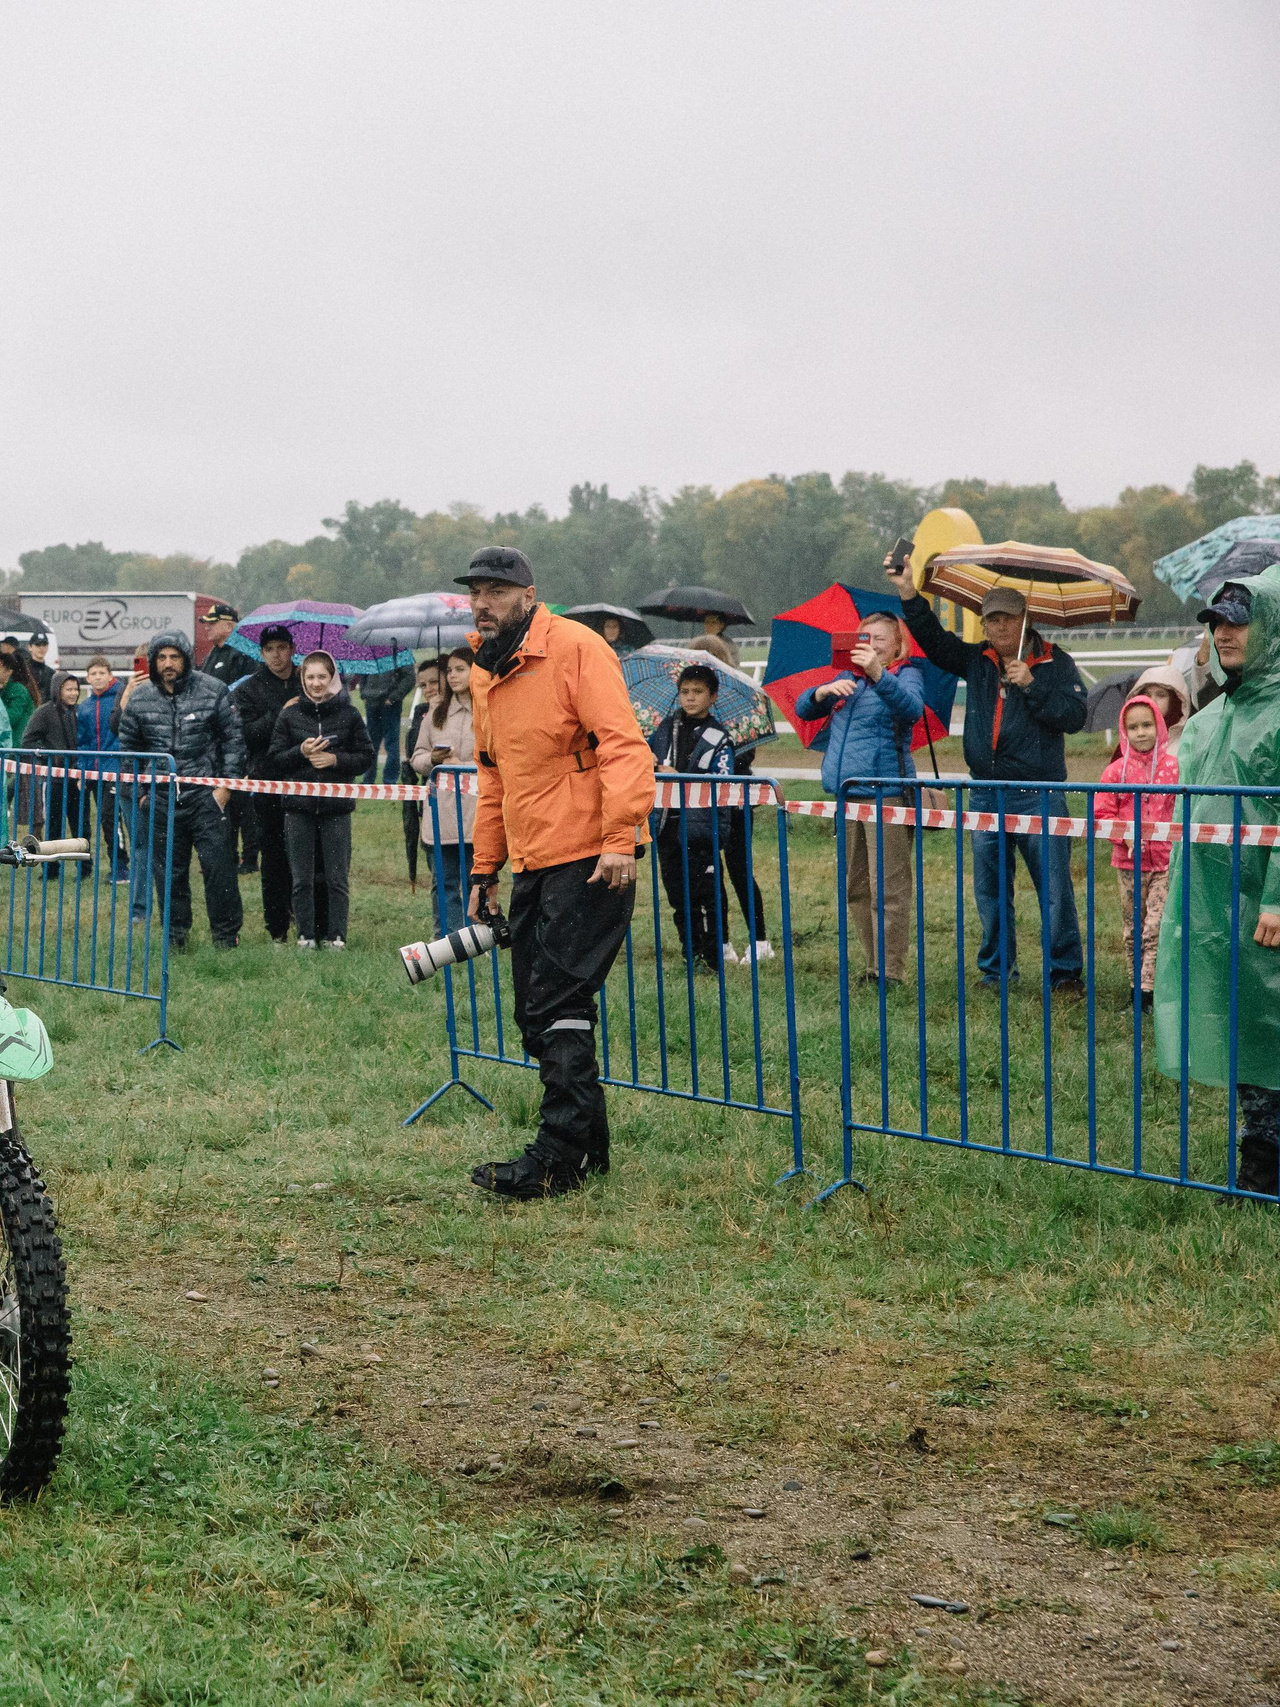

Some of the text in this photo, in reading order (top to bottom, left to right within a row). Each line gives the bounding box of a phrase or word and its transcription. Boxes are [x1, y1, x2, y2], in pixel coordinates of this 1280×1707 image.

[43, 609, 172, 631] EURO EX GROUP
